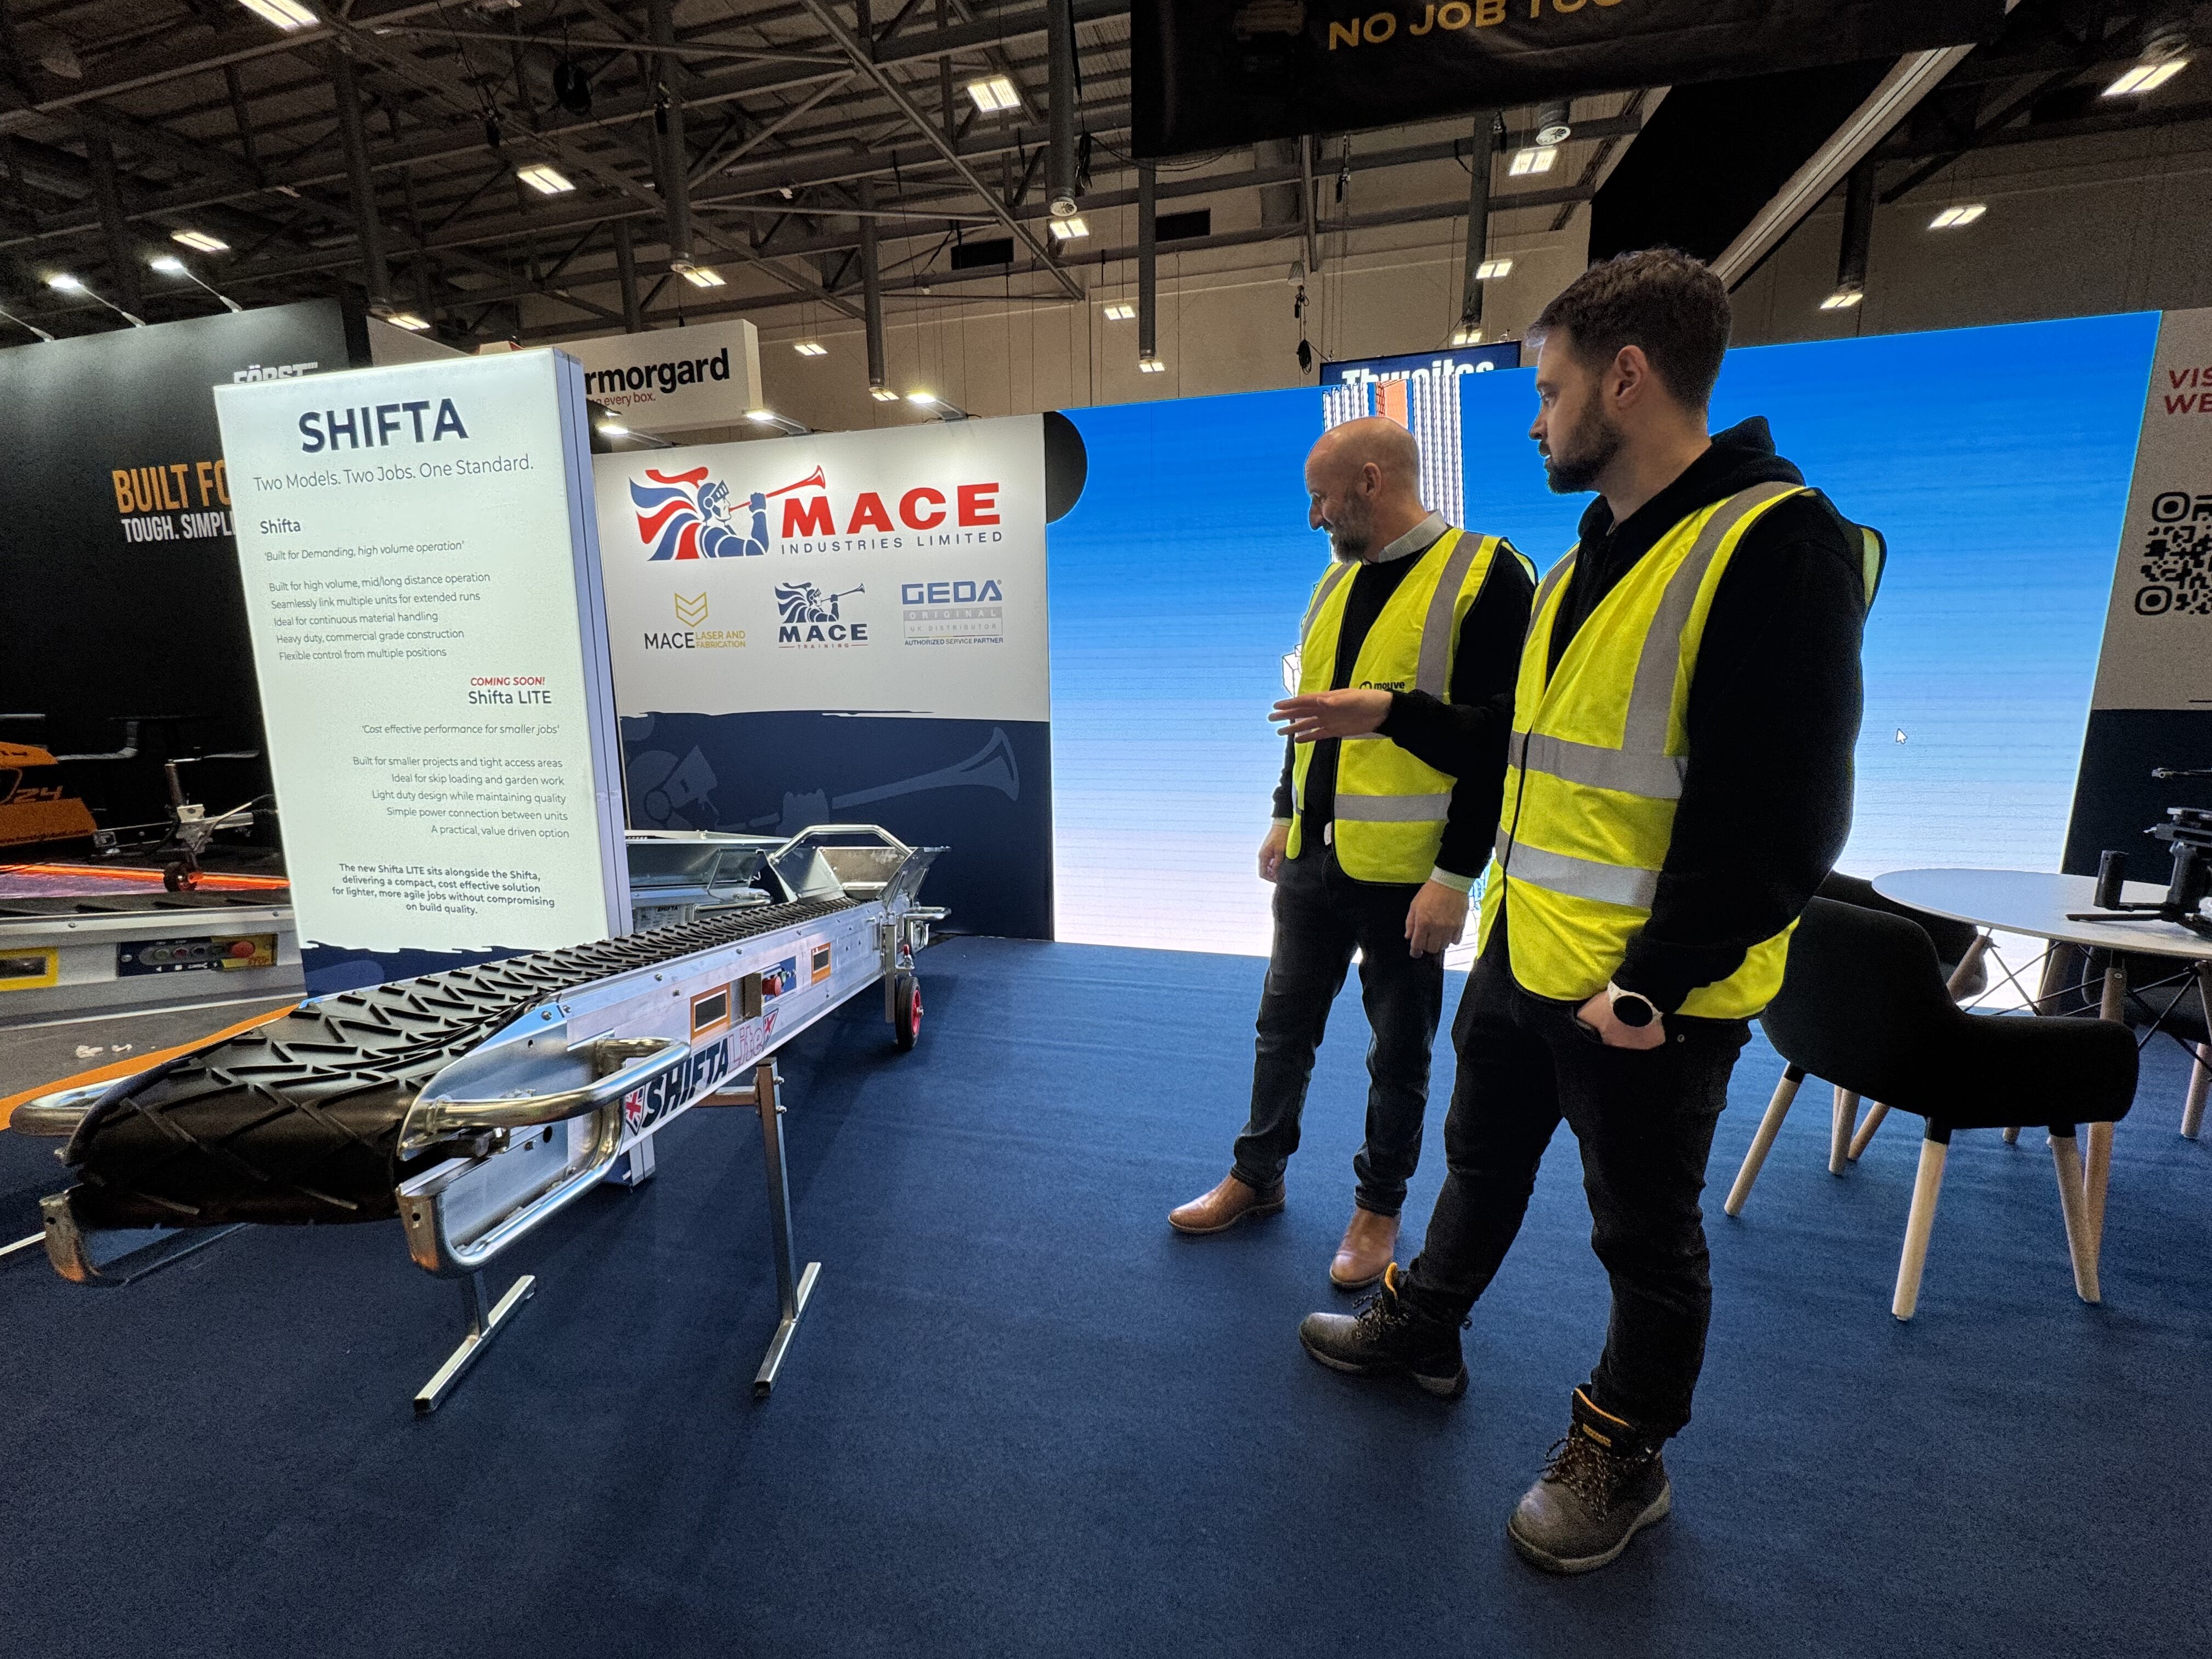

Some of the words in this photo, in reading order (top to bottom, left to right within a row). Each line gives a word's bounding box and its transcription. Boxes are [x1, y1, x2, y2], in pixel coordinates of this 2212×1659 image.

[1329, 12, 1396, 50] NO
[1409, 0, 1505, 36] JOB
[2169, 366, 2212, 389] VIS
[604, 394, 631, 407] every
[633, 392, 656, 403] box.
[298, 398, 470, 454] SHIFTA
[252, 477, 283, 492] Two
[286, 470, 341, 489] Models.
[342, 469, 374, 484] Two
[377, 464, 416, 482] Jobs.
[419, 462, 452, 478] One
[456, 453, 534, 475] Standard.
[112, 464, 188, 514] BUILT
[782, 483, 1000, 538] MACE
[121, 516, 180, 543] TOUGH.
[259, 518, 301, 534] Shifta
[782, 537, 902, 555] INDUSTRIES
[917, 531, 1002, 546] LIMITED
[287, 550, 300, 560] for
[301, 547, 356, 559] Demanding,
[358, 545, 379, 557] high
[380, 544, 414, 554] volume
[269, 582, 290, 592] Built
[290, 581, 302, 591] for
[303, 579, 324, 592] high
[325, 579, 360, 589] volume,
[361, 575, 403, 588] mid/long
[404, 575, 443, 585] distance
[445, 572, 490, 585] operation
[270, 598, 317, 610] Seamlessly
[318, 596, 335, 607] link
[336, 595, 374, 607] multiple
[374, 594, 398, 605] units
[398, 593, 412, 604] for
[413, 591, 457, 603] extended
[459, 592, 481, 601] runs
[902, 580, 1002, 605] GEDA
[274, 617, 294, 627] Ideal
[295, 616, 307, 625] for
[309, 614, 358, 625] continuous
[359, 612, 396, 623] material
[397, 611, 438, 623] handling
[909, 610, 996, 620] ORIGINAL
[695, 631, 724, 640] LASER
[726, 630, 746, 640] AND
[778, 623, 868, 643] MACE
[928, 623, 997, 632] DISTRIBUTOR
[276, 634, 302, 645] Heavy
[303, 633, 325, 644] duty,
[325, 631, 377, 642] commercial
[379, 630, 405, 642] grade
[406, 628, 465, 640] construction
[644, 632, 695, 650] MACE
[696, 640, 746, 649] FABRICATION
[279, 650, 311, 661] Flexible
[312, 650, 343, 660] control
[343, 649, 365, 659] from
[366, 648, 404, 660] multiple
[405, 647, 447, 659] positions
[470, 676, 511, 686] COMING
[512, 676, 546, 686] SOON!
[468, 689, 514, 704] Shifta
[518, 690, 552, 704] LITE
[384, 724, 422, 733] effective
[424, 724, 483, 735] performance
[484, 724, 498, 734] for
[499, 724, 536, 734] smaller
[353, 756, 374, 765] Built
[374, 756, 387, 765] for
[388, 757, 420, 766] smaller
[422, 757, 459, 768] projects
[460, 757, 478, 766] and
[479, 757, 503, 769] tight
[504, 759, 535, 768] access
[537, 760, 563, 768] areas
[391, 773, 413, 783] Ideal
[414, 773, 427, 783] for
[428, 773, 447, 785] skip
[448, 774, 483, 786] loading
[485, 775, 503, 785] and
[505, 775, 539, 787] garden
[540, 776, 565, 786] work
[372, 789, 395, 801] Light
[396, 789, 416, 802] duty
[417, 791, 448, 802] design
[449, 791, 474, 801] while
[476, 792, 532, 804] maintaining
[534, 793, 567, 805] quality
[386, 806, 417, 818] Simple
[419, 809, 447, 818] power
[448, 808, 499, 819] connection
[500, 809, 542, 820] between
[544, 811, 568, 821] units
[431, 825, 438, 833] A
[439, 825, 480, 836] practical,
[480, 826, 506, 836] value
[507, 826, 537, 837] driven
[538, 828, 569, 839] option
[338, 863, 356, 872] The
[377, 864, 404, 874] Shifta
[405, 866, 425, 875] LITE
[426, 866, 443, 876] sits
[444, 867, 490, 879] alongside
[491, 869, 508, 879] the
[510, 870, 541, 882] Shifta,
[342, 874, 385, 887] delivering
[394, 879, 437, 889] compact,
[438, 881, 458, 889] cost
[459, 880, 500, 891] effective
[501, 882, 541, 893] solution
[331, 886, 345, 895] for
[346, 887, 377, 899] lighter,
[403, 889, 426, 901] agile
[426, 890, 447, 901] jobs
[448, 891, 485, 902] without
[486, 895, 555, 909] compromising
[419, 902, 442, 912] build
[444, 904, 478, 916] quality.
[642, 1037, 729, 1128] SHIFTA
